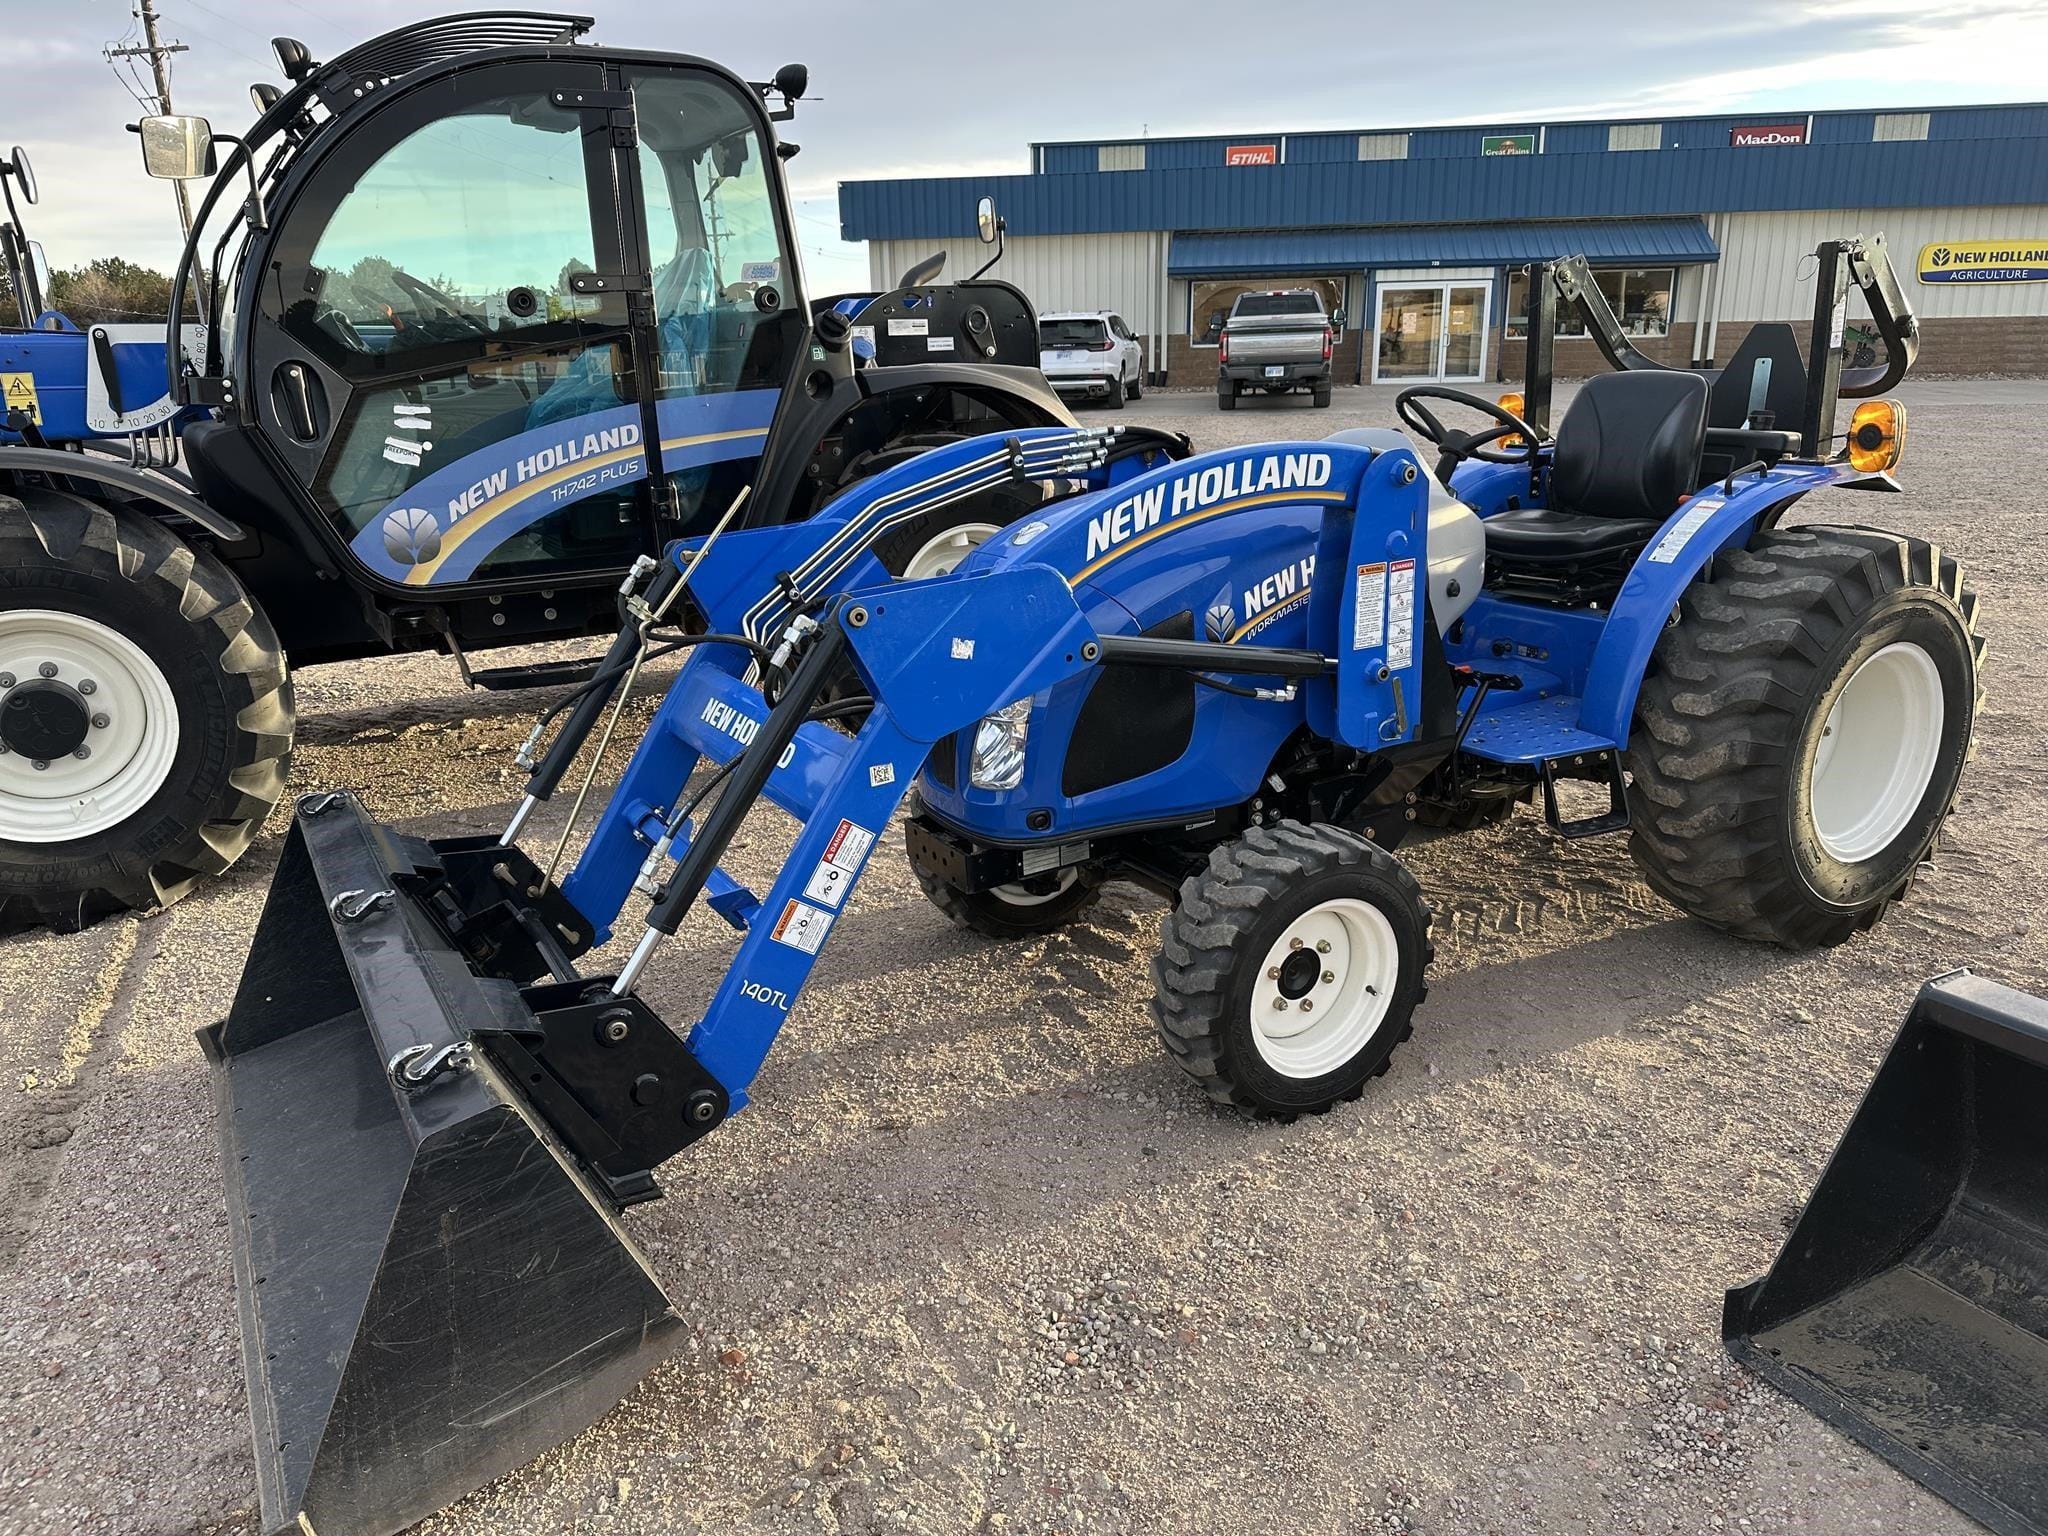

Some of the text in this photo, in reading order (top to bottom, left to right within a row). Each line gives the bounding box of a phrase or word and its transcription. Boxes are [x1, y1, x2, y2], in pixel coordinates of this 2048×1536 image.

[1736, 133, 1800, 145] MacDon
[1231, 153, 1271, 165] STIHL
[1953, 252, 1986, 263] NEW
[1950, 269, 2029, 280] AGRICULTURE
[127, 417, 140, 427] 10
[143, 412, 157, 424] 20
[158, 405, 171, 417] 30
[448, 423, 640, 524] NEW HOLLAND
[600, 460, 639, 485] PLUS
[1086, 453, 1332, 561] NEW HOLLAND
[1244, 564, 1295, 620] NEW
[1247, 593, 1311, 641] WORKMASTE
[701, 697, 737, 732] NEW
[831, 823, 848, 853] DANGER
[780, 904, 796, 928] WARNING
[739, 979, 789, 1011] 140TL
